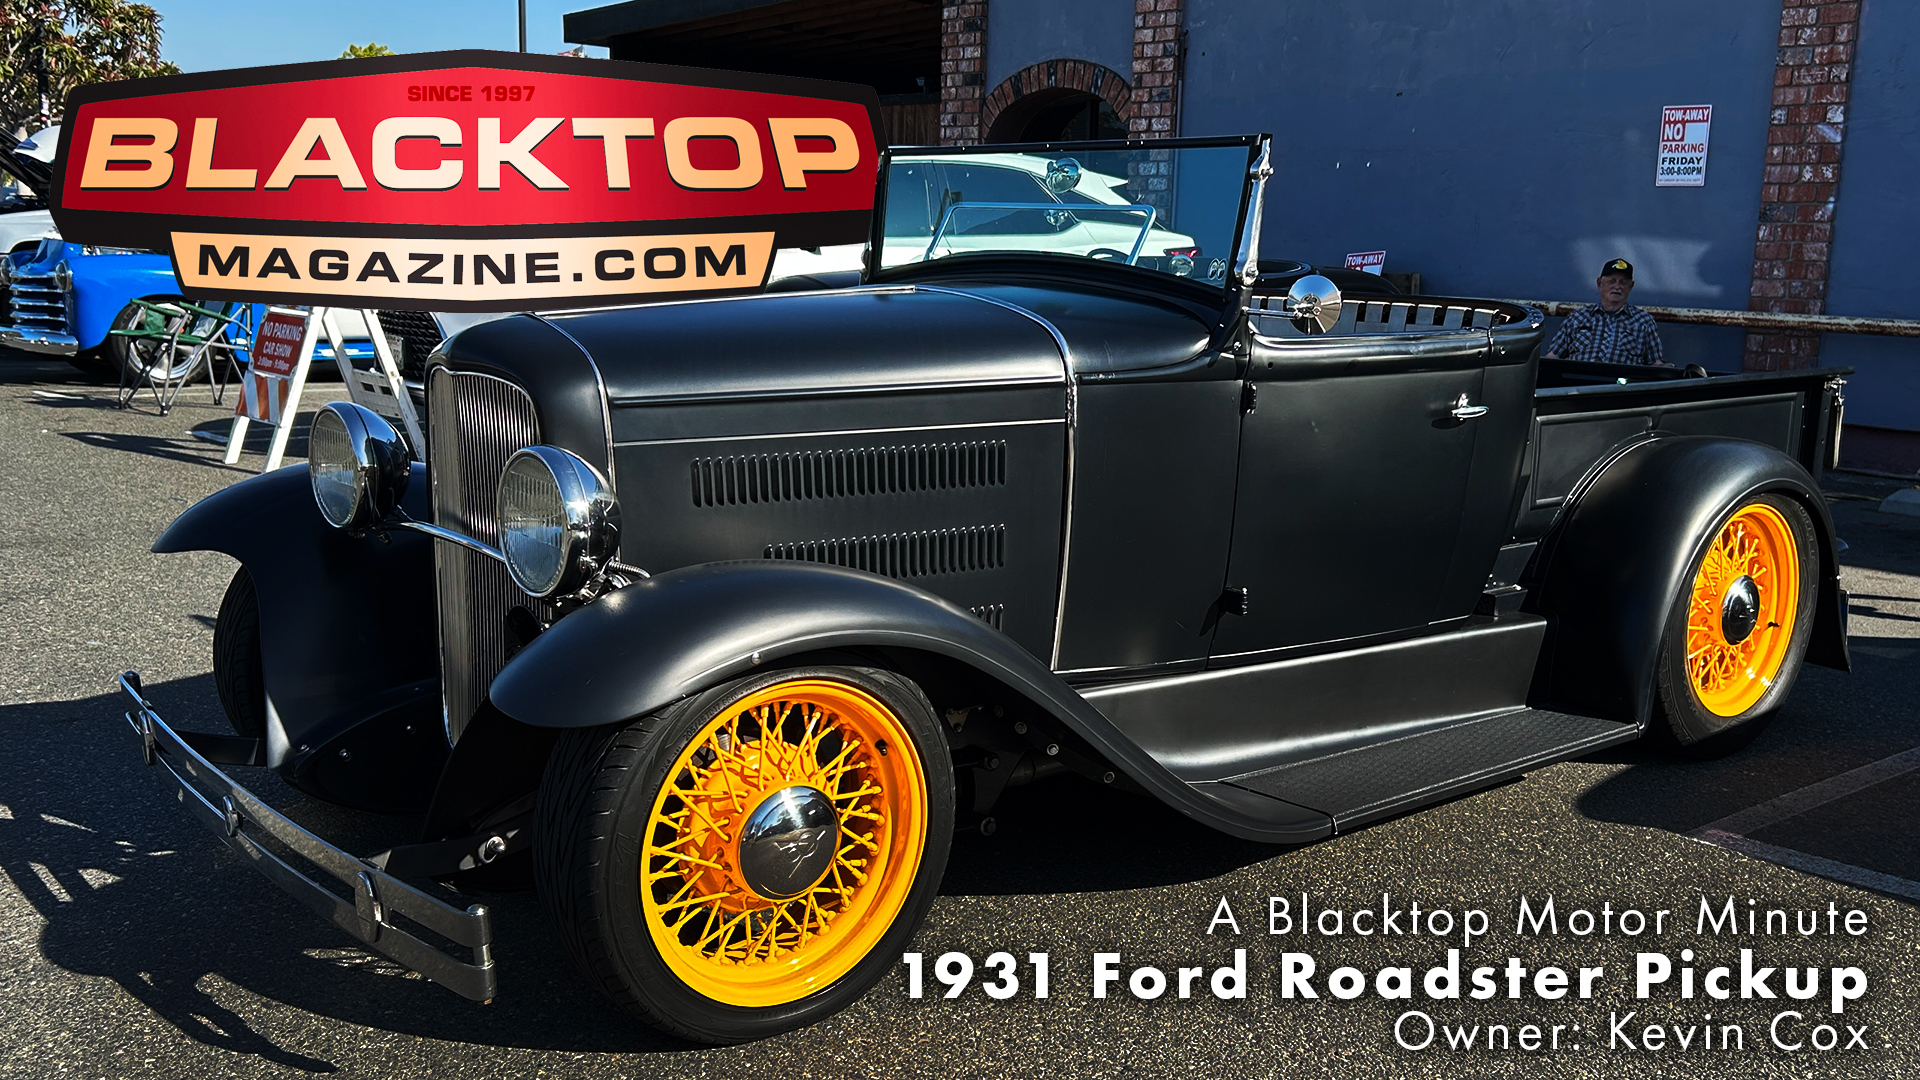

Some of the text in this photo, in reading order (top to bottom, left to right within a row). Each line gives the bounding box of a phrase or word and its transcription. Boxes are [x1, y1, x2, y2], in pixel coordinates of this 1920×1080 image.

[1664, 109, 1709, 121] TOW-AWAY
[1663, 123, 1684, 140] NO
[1661, 143, 1704, 154] PARKING
[1661, 156, 1703, 166] FRIDAY
[1347, 254, 1384, 267] TOW-AWAY
[262, 321, 303, 342] NO PARKING
[262, 341, 293, 358] CAR SHOW
